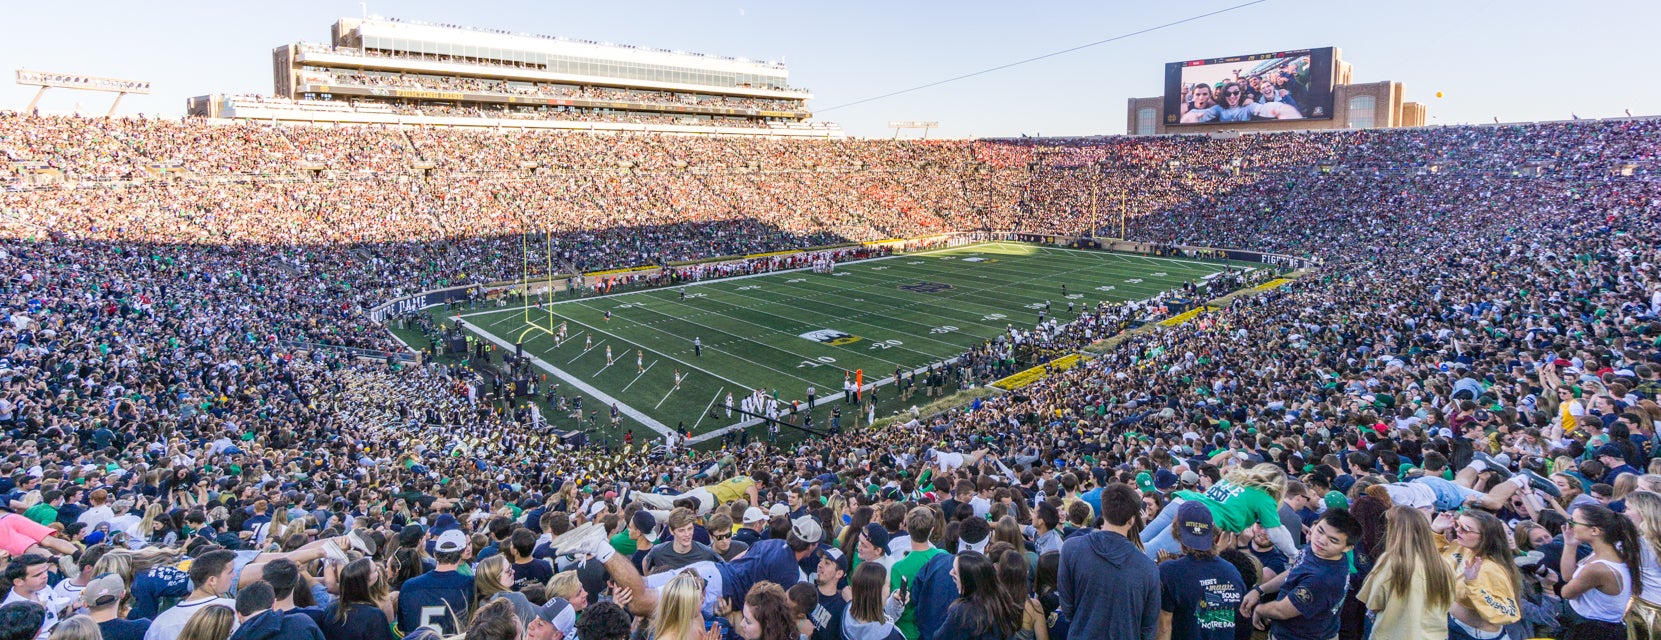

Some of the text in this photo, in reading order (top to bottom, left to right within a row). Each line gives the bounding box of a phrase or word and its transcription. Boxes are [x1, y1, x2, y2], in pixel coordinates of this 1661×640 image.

[1261, 254, 1299, 267] FIGNG
[872, 339, 904, 350] 20
[800, 356, 837, 368] 10
[1208, 581, 1235, 592] magic
[1201, 620, 1223, 629] NOTRE
